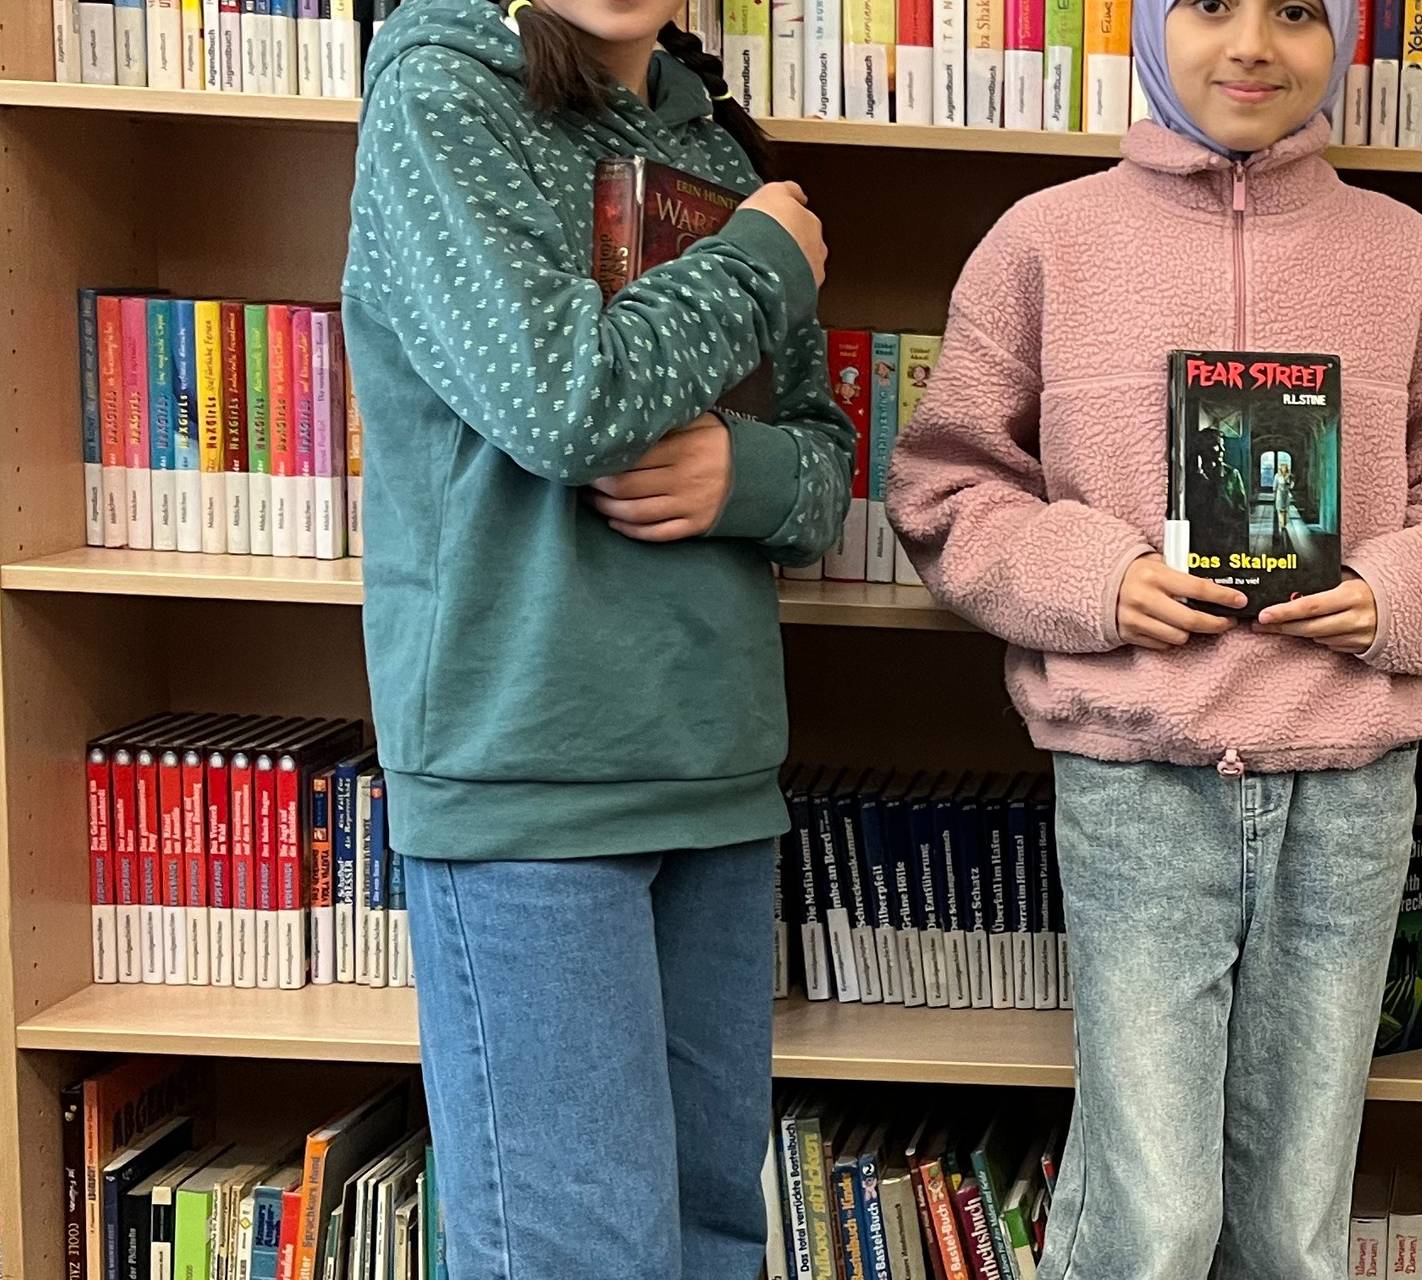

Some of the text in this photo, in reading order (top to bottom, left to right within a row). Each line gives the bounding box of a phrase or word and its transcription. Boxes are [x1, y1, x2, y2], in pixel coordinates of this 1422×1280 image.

[819, 53, 827, 116] Jugendbuch
[865, 55, 873, 118] Jugendbuch
[1187, 360, 1327, 391] FEAR STREET
[1188, 552, 1297, 572] Das Skalpell
[821, 832, 835, 863] Bord
[970, 867, 981, 909] Schatz
[787, 1123, 810, 1272] Das total verrückte Bastelbuch
[867, 1202, 886, 1271] Bastel-Buch
[935, 1203, 962, 1271] Bastel-Buch
